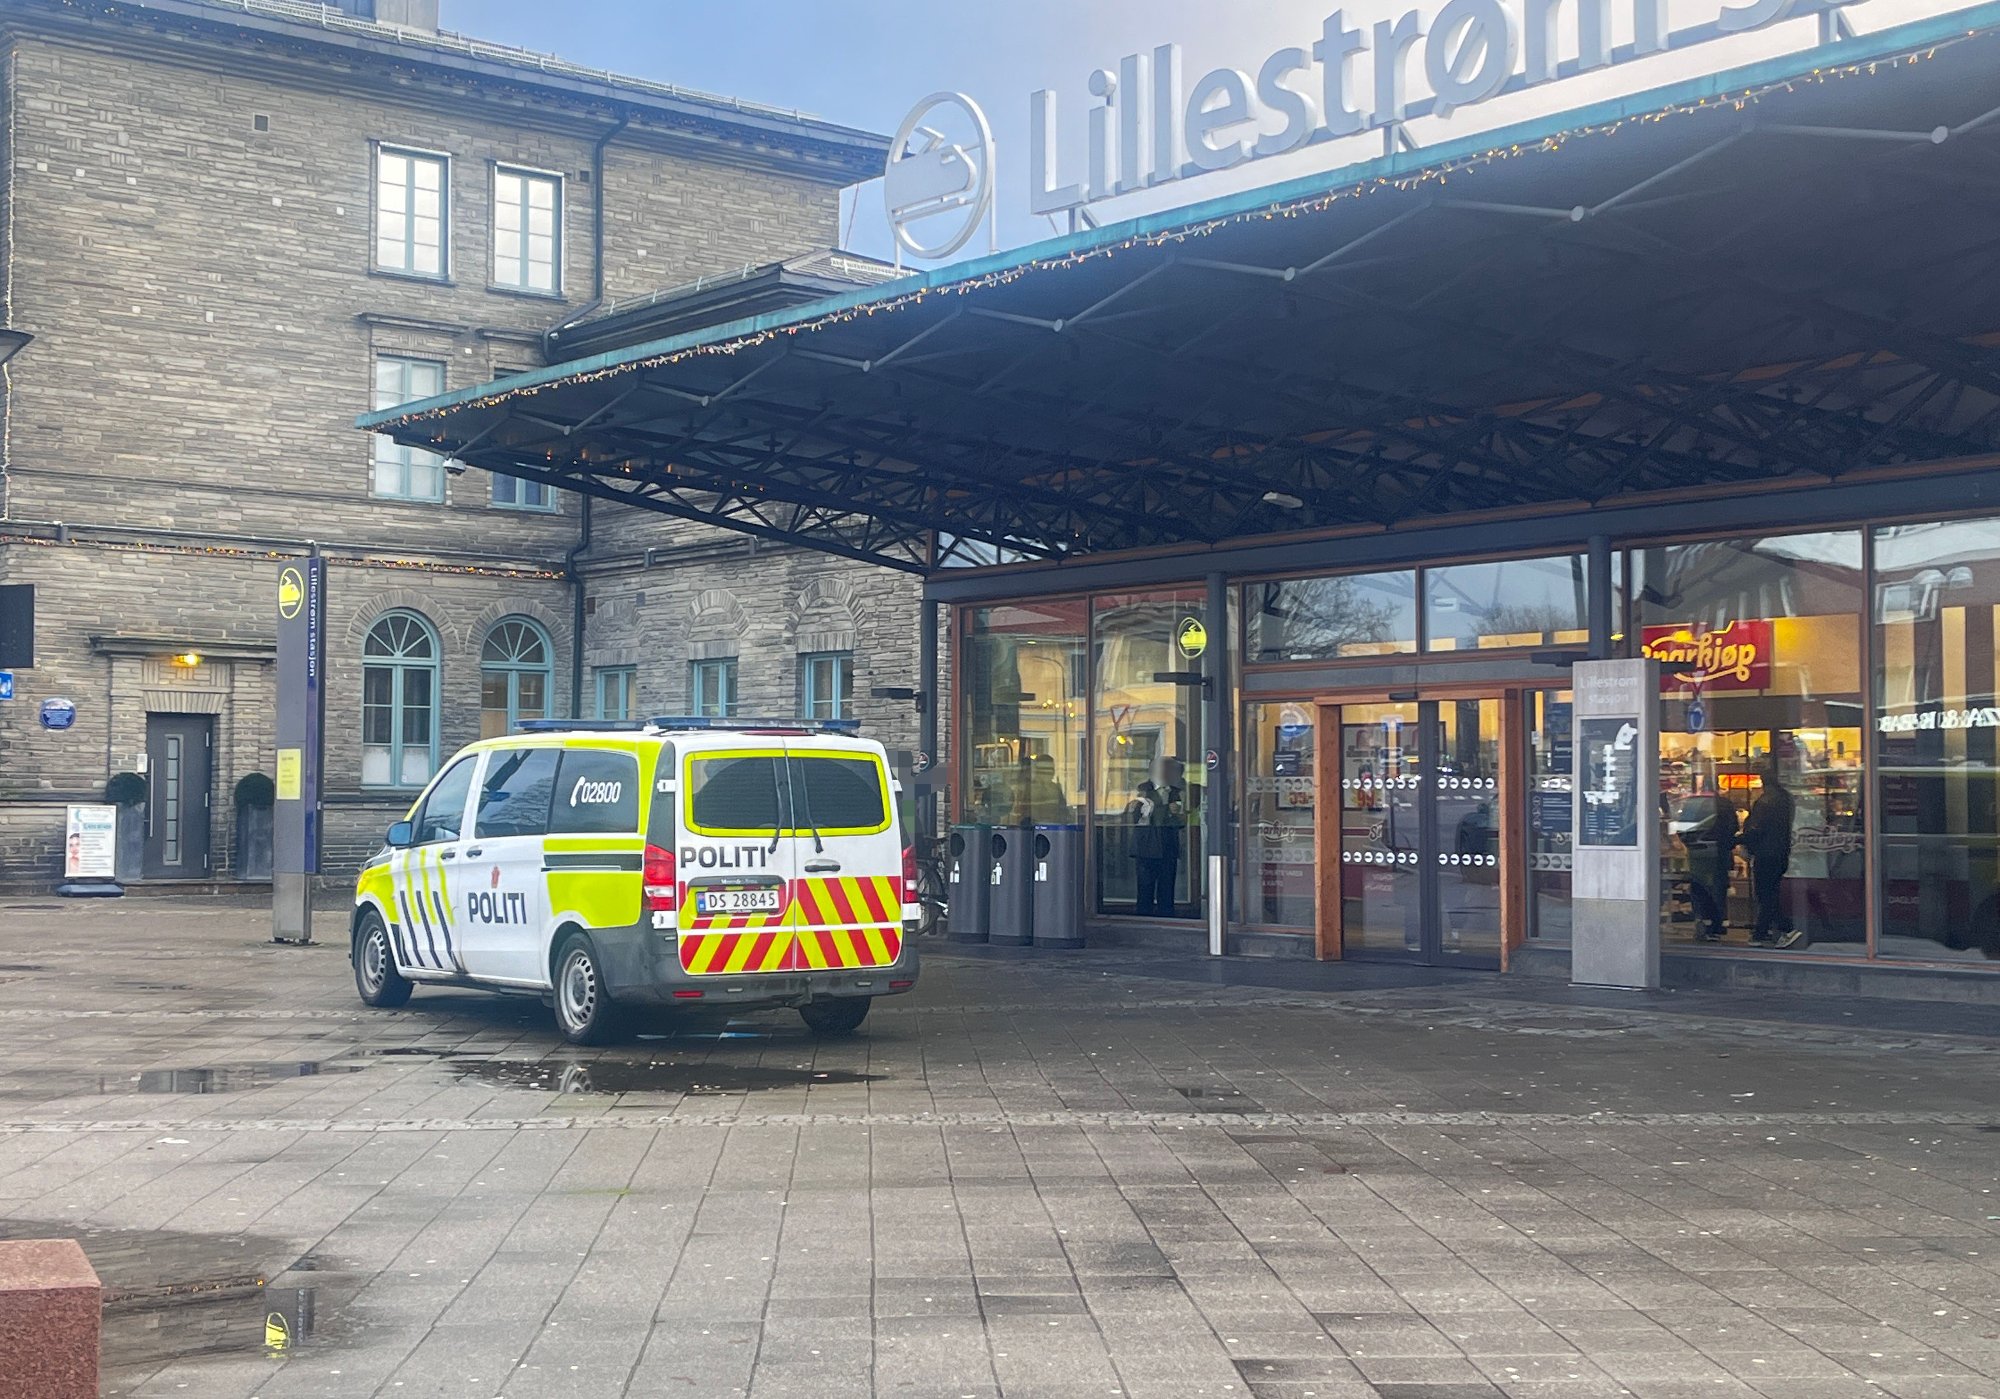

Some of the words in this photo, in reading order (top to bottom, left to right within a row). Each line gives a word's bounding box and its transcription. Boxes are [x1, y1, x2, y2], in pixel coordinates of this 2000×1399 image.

[309, 567, 318, 629] Lillestrøm
[308, 631, 316, 677] stasjon
[1642, 632, 1757, 681] narkjøp
[581, 781, 622, 803] 02800
[679, 846, 766, 868] POLITI
[468, 892, 527, 924] POLITI
[709, 894, 726, 908] DS
[732, 892, 775, 908] 28845
